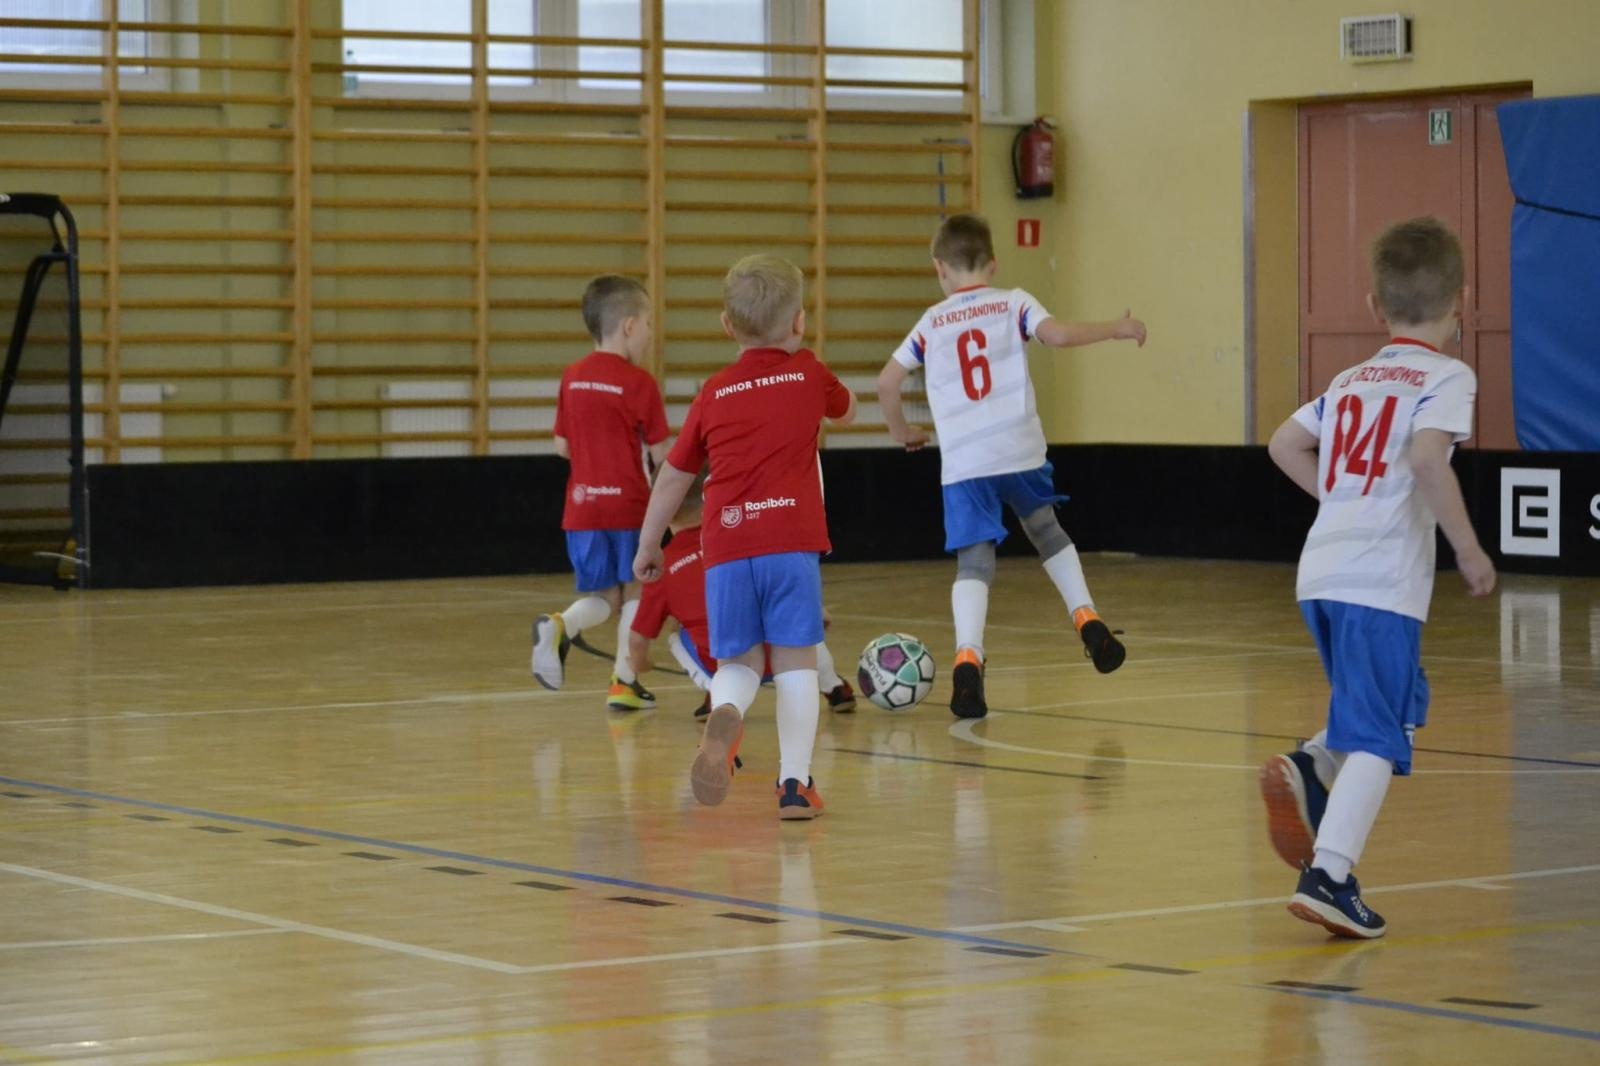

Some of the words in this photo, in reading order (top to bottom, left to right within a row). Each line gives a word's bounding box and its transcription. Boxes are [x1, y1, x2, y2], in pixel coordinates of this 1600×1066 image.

[957, 328, 992, 402] 6
[715, 381, 752, 399] JUNIOR
[755, 372, 805, 388] TRENING
[744, 496, 796, 511] Racibórz
